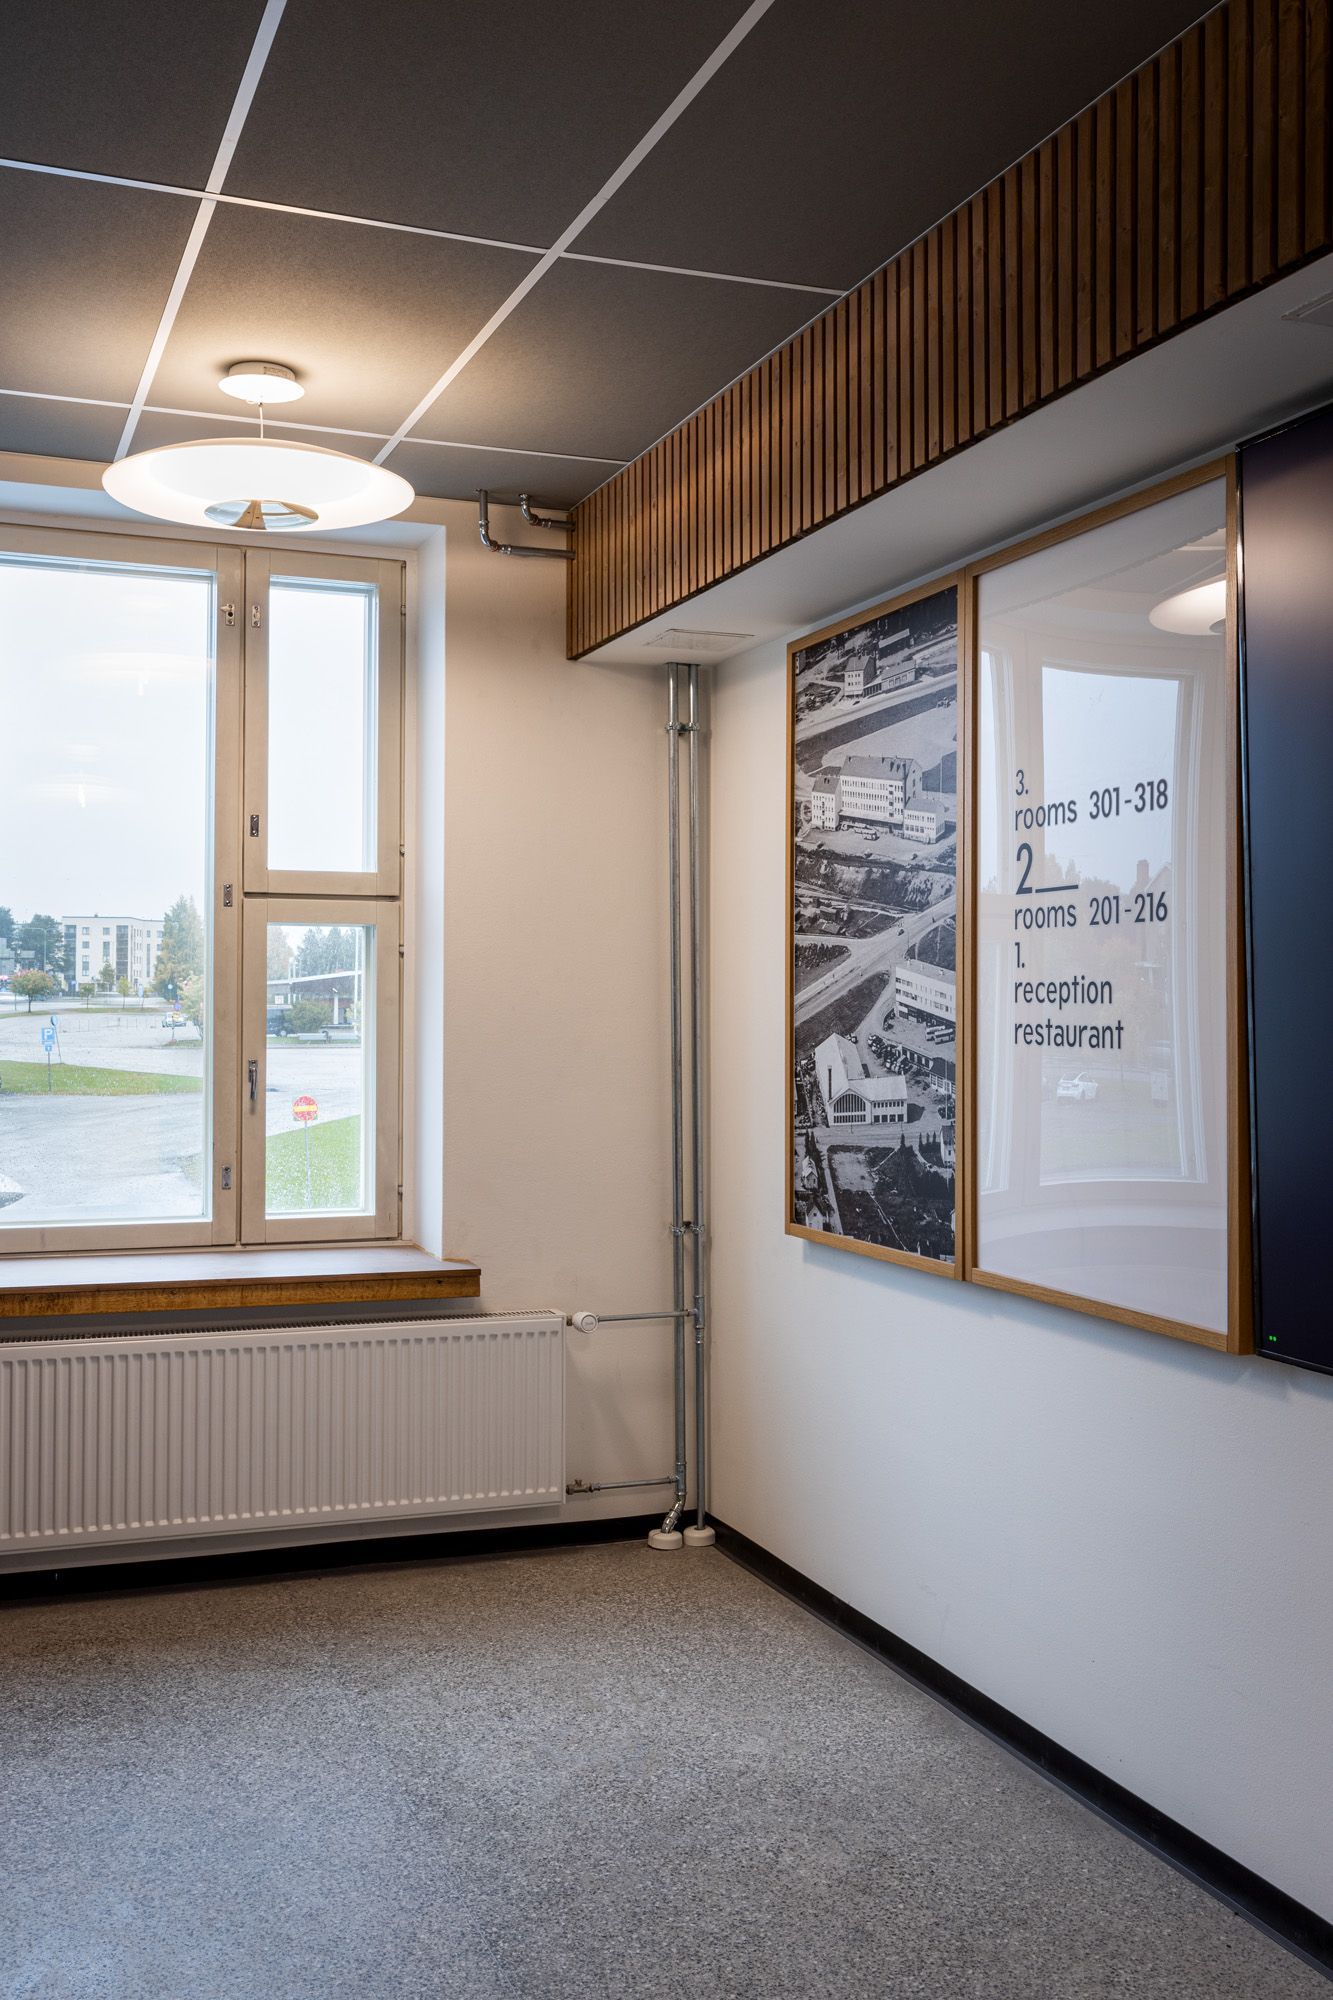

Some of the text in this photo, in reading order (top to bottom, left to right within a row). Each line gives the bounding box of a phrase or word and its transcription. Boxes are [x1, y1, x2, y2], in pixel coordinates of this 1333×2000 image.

[1015, 769, 1028, 796] 3.
[1014, 778, 1168, 831] rooms 301-318
[1014, 891, 1168, 930] rooms 201-216
[1014, 942, 1025, 968] 1.
[1014, 974, 1113, 1010] reception
[1014, 1018, 1124, 1050] restaurant
